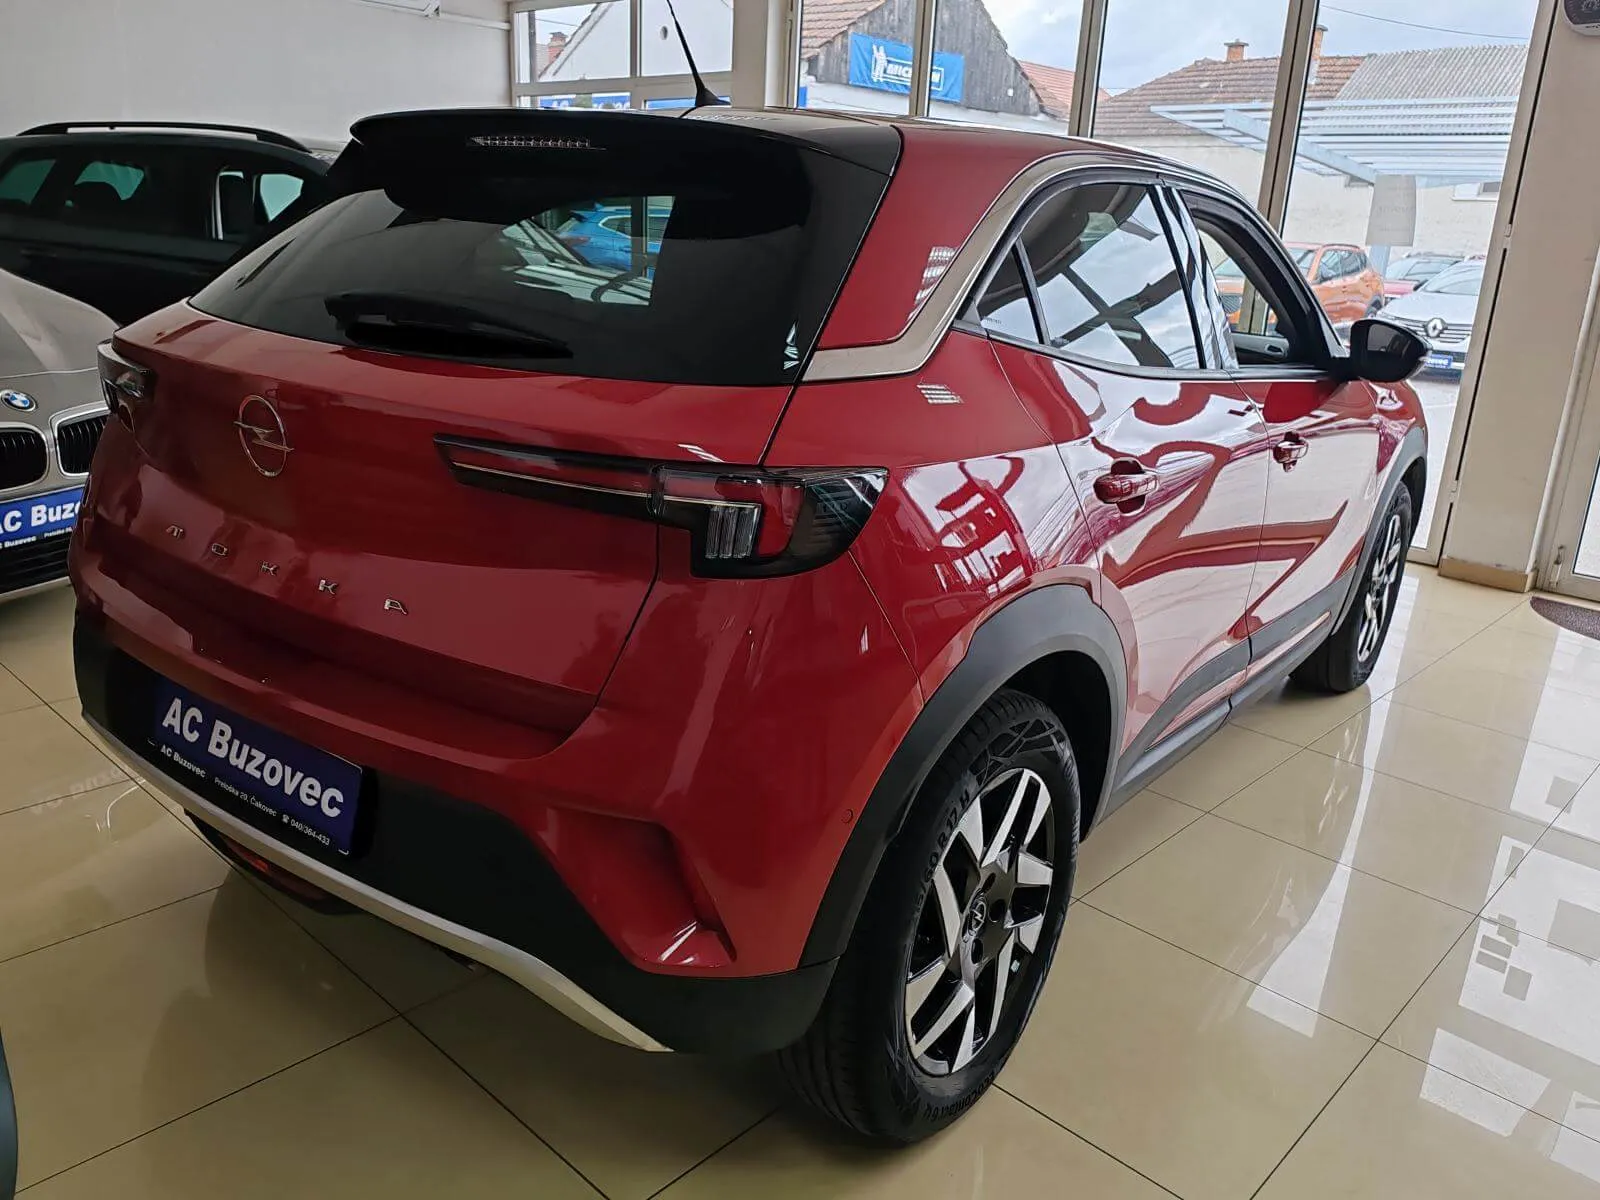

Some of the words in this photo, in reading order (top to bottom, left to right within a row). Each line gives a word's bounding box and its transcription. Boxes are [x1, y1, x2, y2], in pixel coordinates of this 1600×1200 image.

[160, 744, 173, 757] AC
[173, 751, 206, 778] Buzovec
[162, 697, 203, 743] AC
[207, 719, 344, 818] Buzovec
